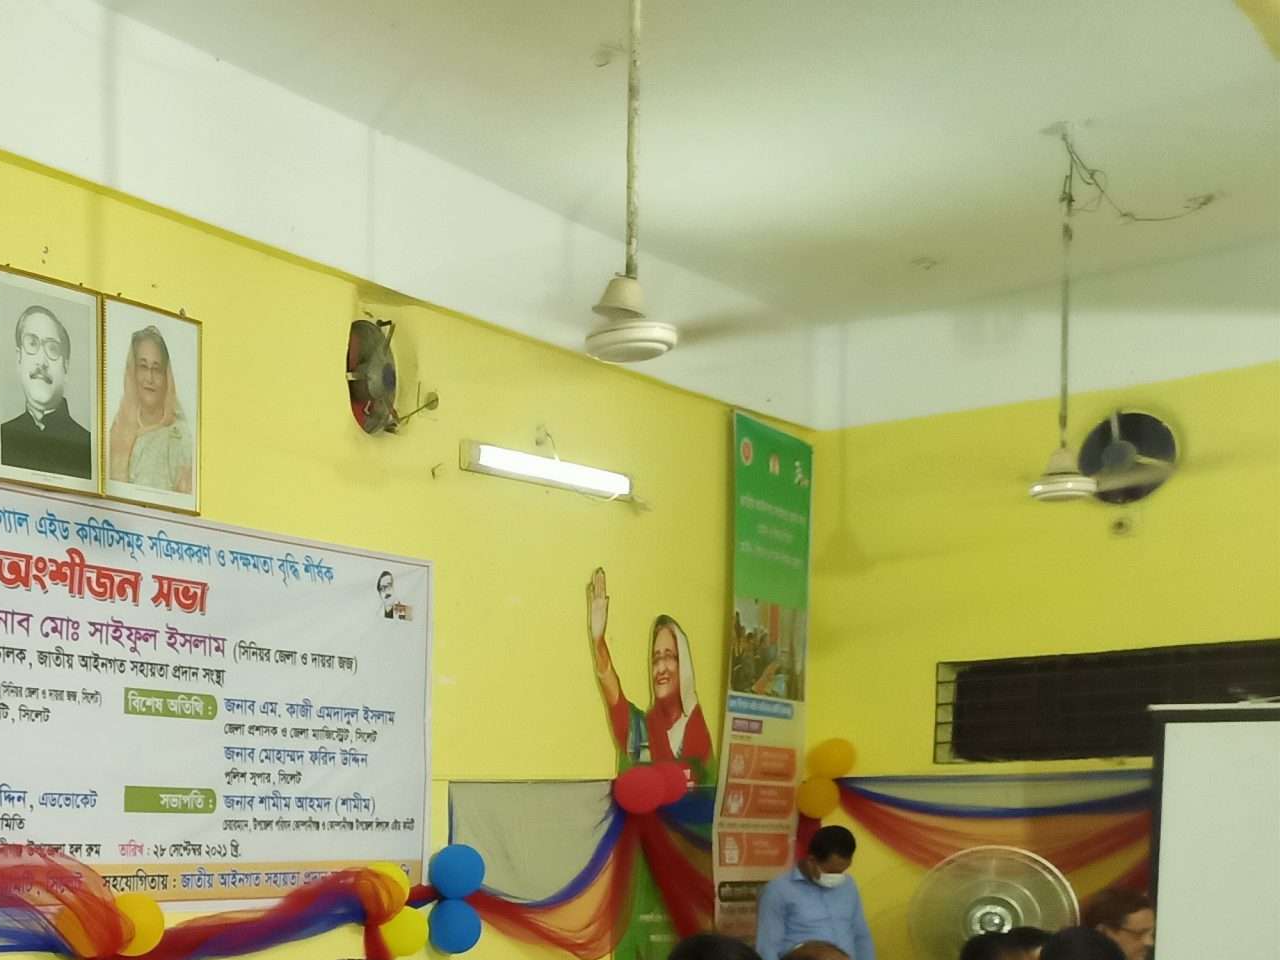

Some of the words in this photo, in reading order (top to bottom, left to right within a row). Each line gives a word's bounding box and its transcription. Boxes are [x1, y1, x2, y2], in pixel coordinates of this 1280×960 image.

[34, 508, 70, 541] এইড
[74, 516, 144, 561] কমিটিসমূহ
[229, 550, 274, 576] সক্ষমতা
[151, 574, 209, 616] সভা
[40, 615, 81, 641] মোঃ
[88, 616, 160, 657] সাইফুল
[165, 624, 228, 660] ইসলাম
[37, 646, 74, 669] জাতীয়
[79, 651, 126, 674] আইনগত
[130, 661, 169, 680] সহায়তা
[171, 664, 199, 682] প্রদান
[19, 706, 51, 723] সিলেট
[127, 691, 163, 713] বিশেষ
[224, 698, 256, 717] জনাব
[286, 698, 313, 720] কাজী
[362, 705, 396, 725] ইসলাম
[224, 746, 256, 763] জনাব
[38, 789, 98, 809] এডভোকেট
[159, 790, 205, 809] সভাপতি
[223, 794, 255, 811] জনাব
[258, 790, 291, 812] শামীম
[102, 868, 169, 891] সহযোগিতায়
[181, 867, 214, 889] জাতীয়
